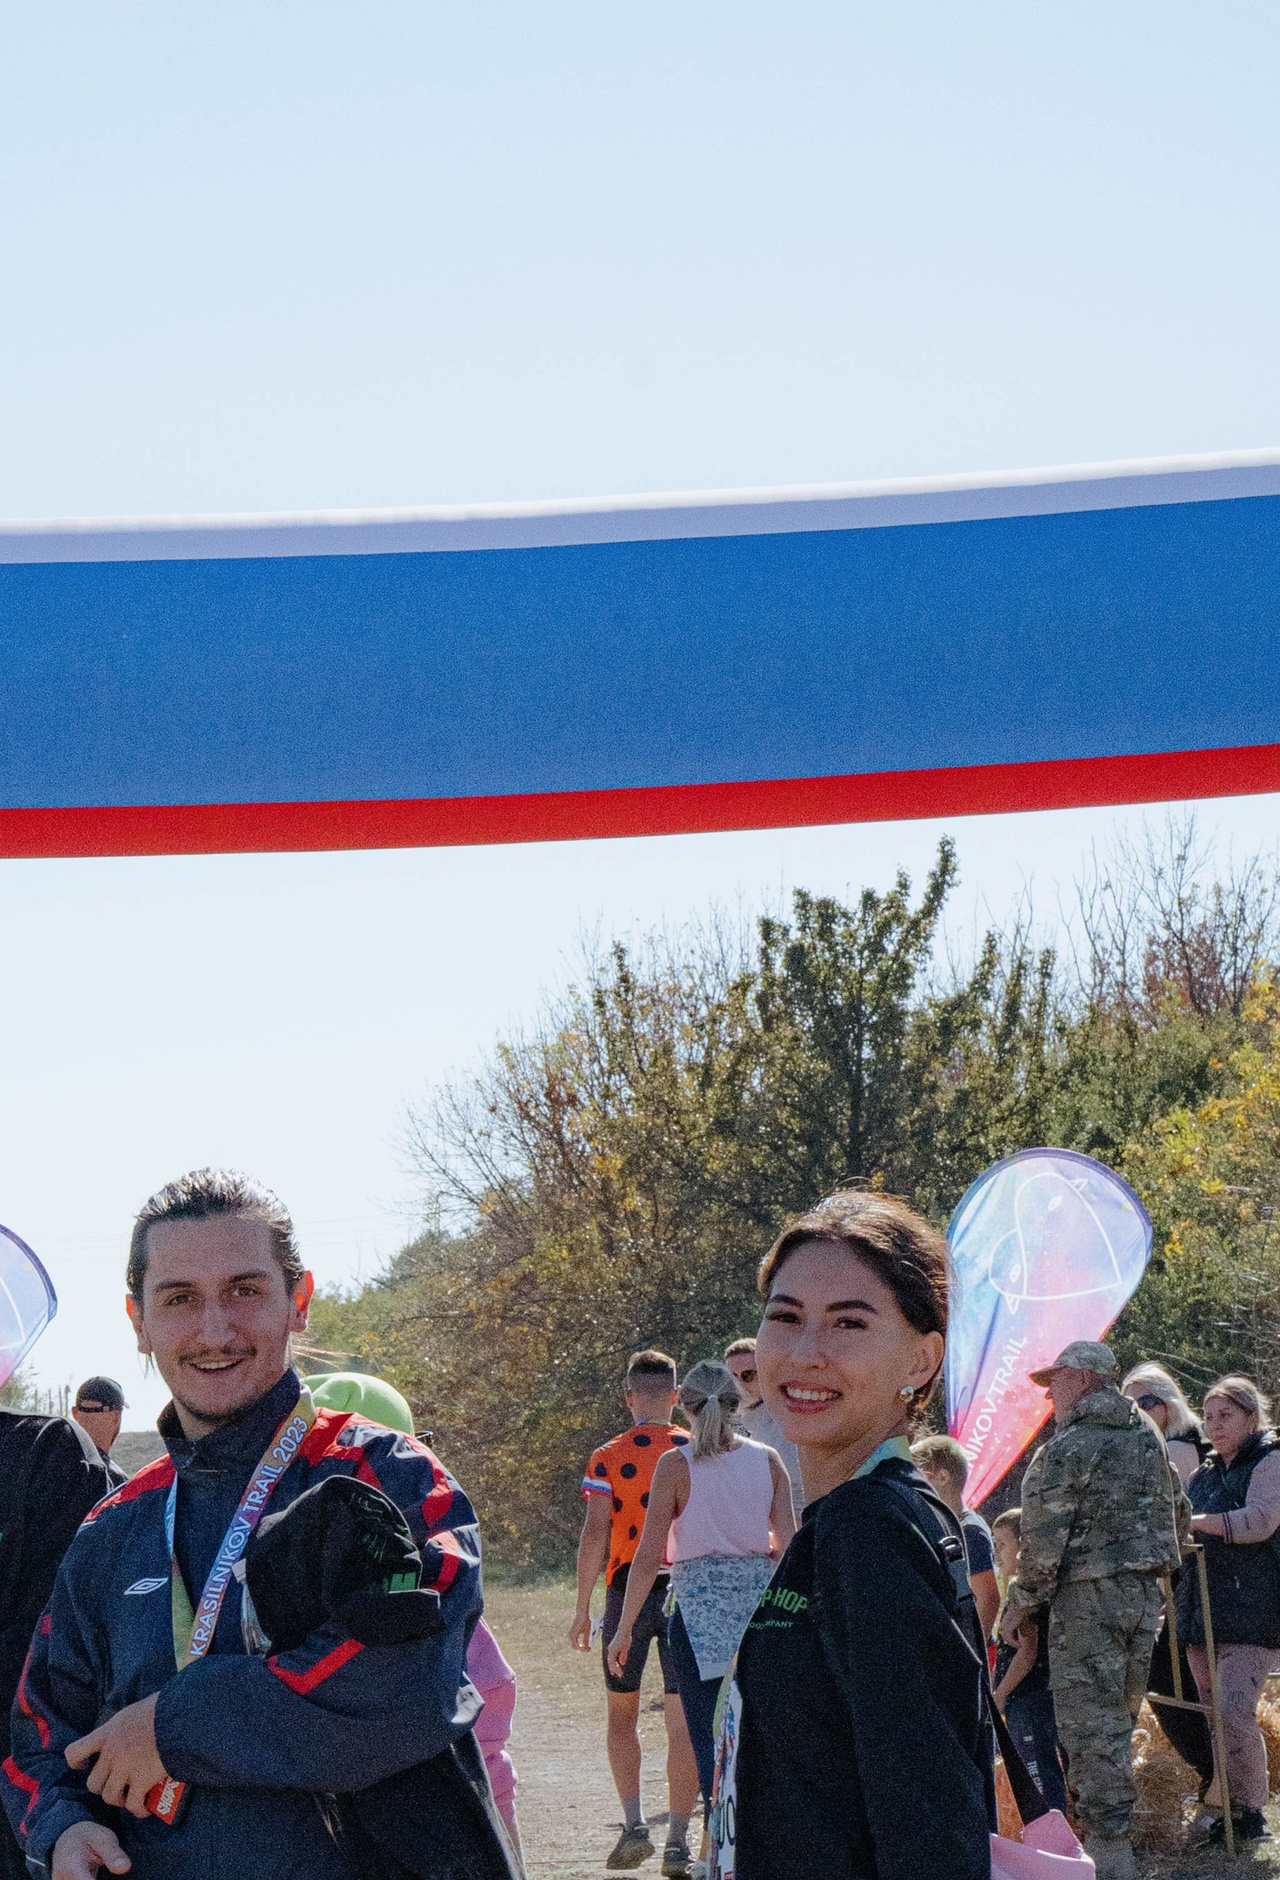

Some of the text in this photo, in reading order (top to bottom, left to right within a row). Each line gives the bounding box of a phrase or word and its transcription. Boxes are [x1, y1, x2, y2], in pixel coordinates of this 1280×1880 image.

[988, 1336, 1028, 1397] TRAIL
[190, 1416, 309, 1656] KRASILNIKOV TRAIL 2023
